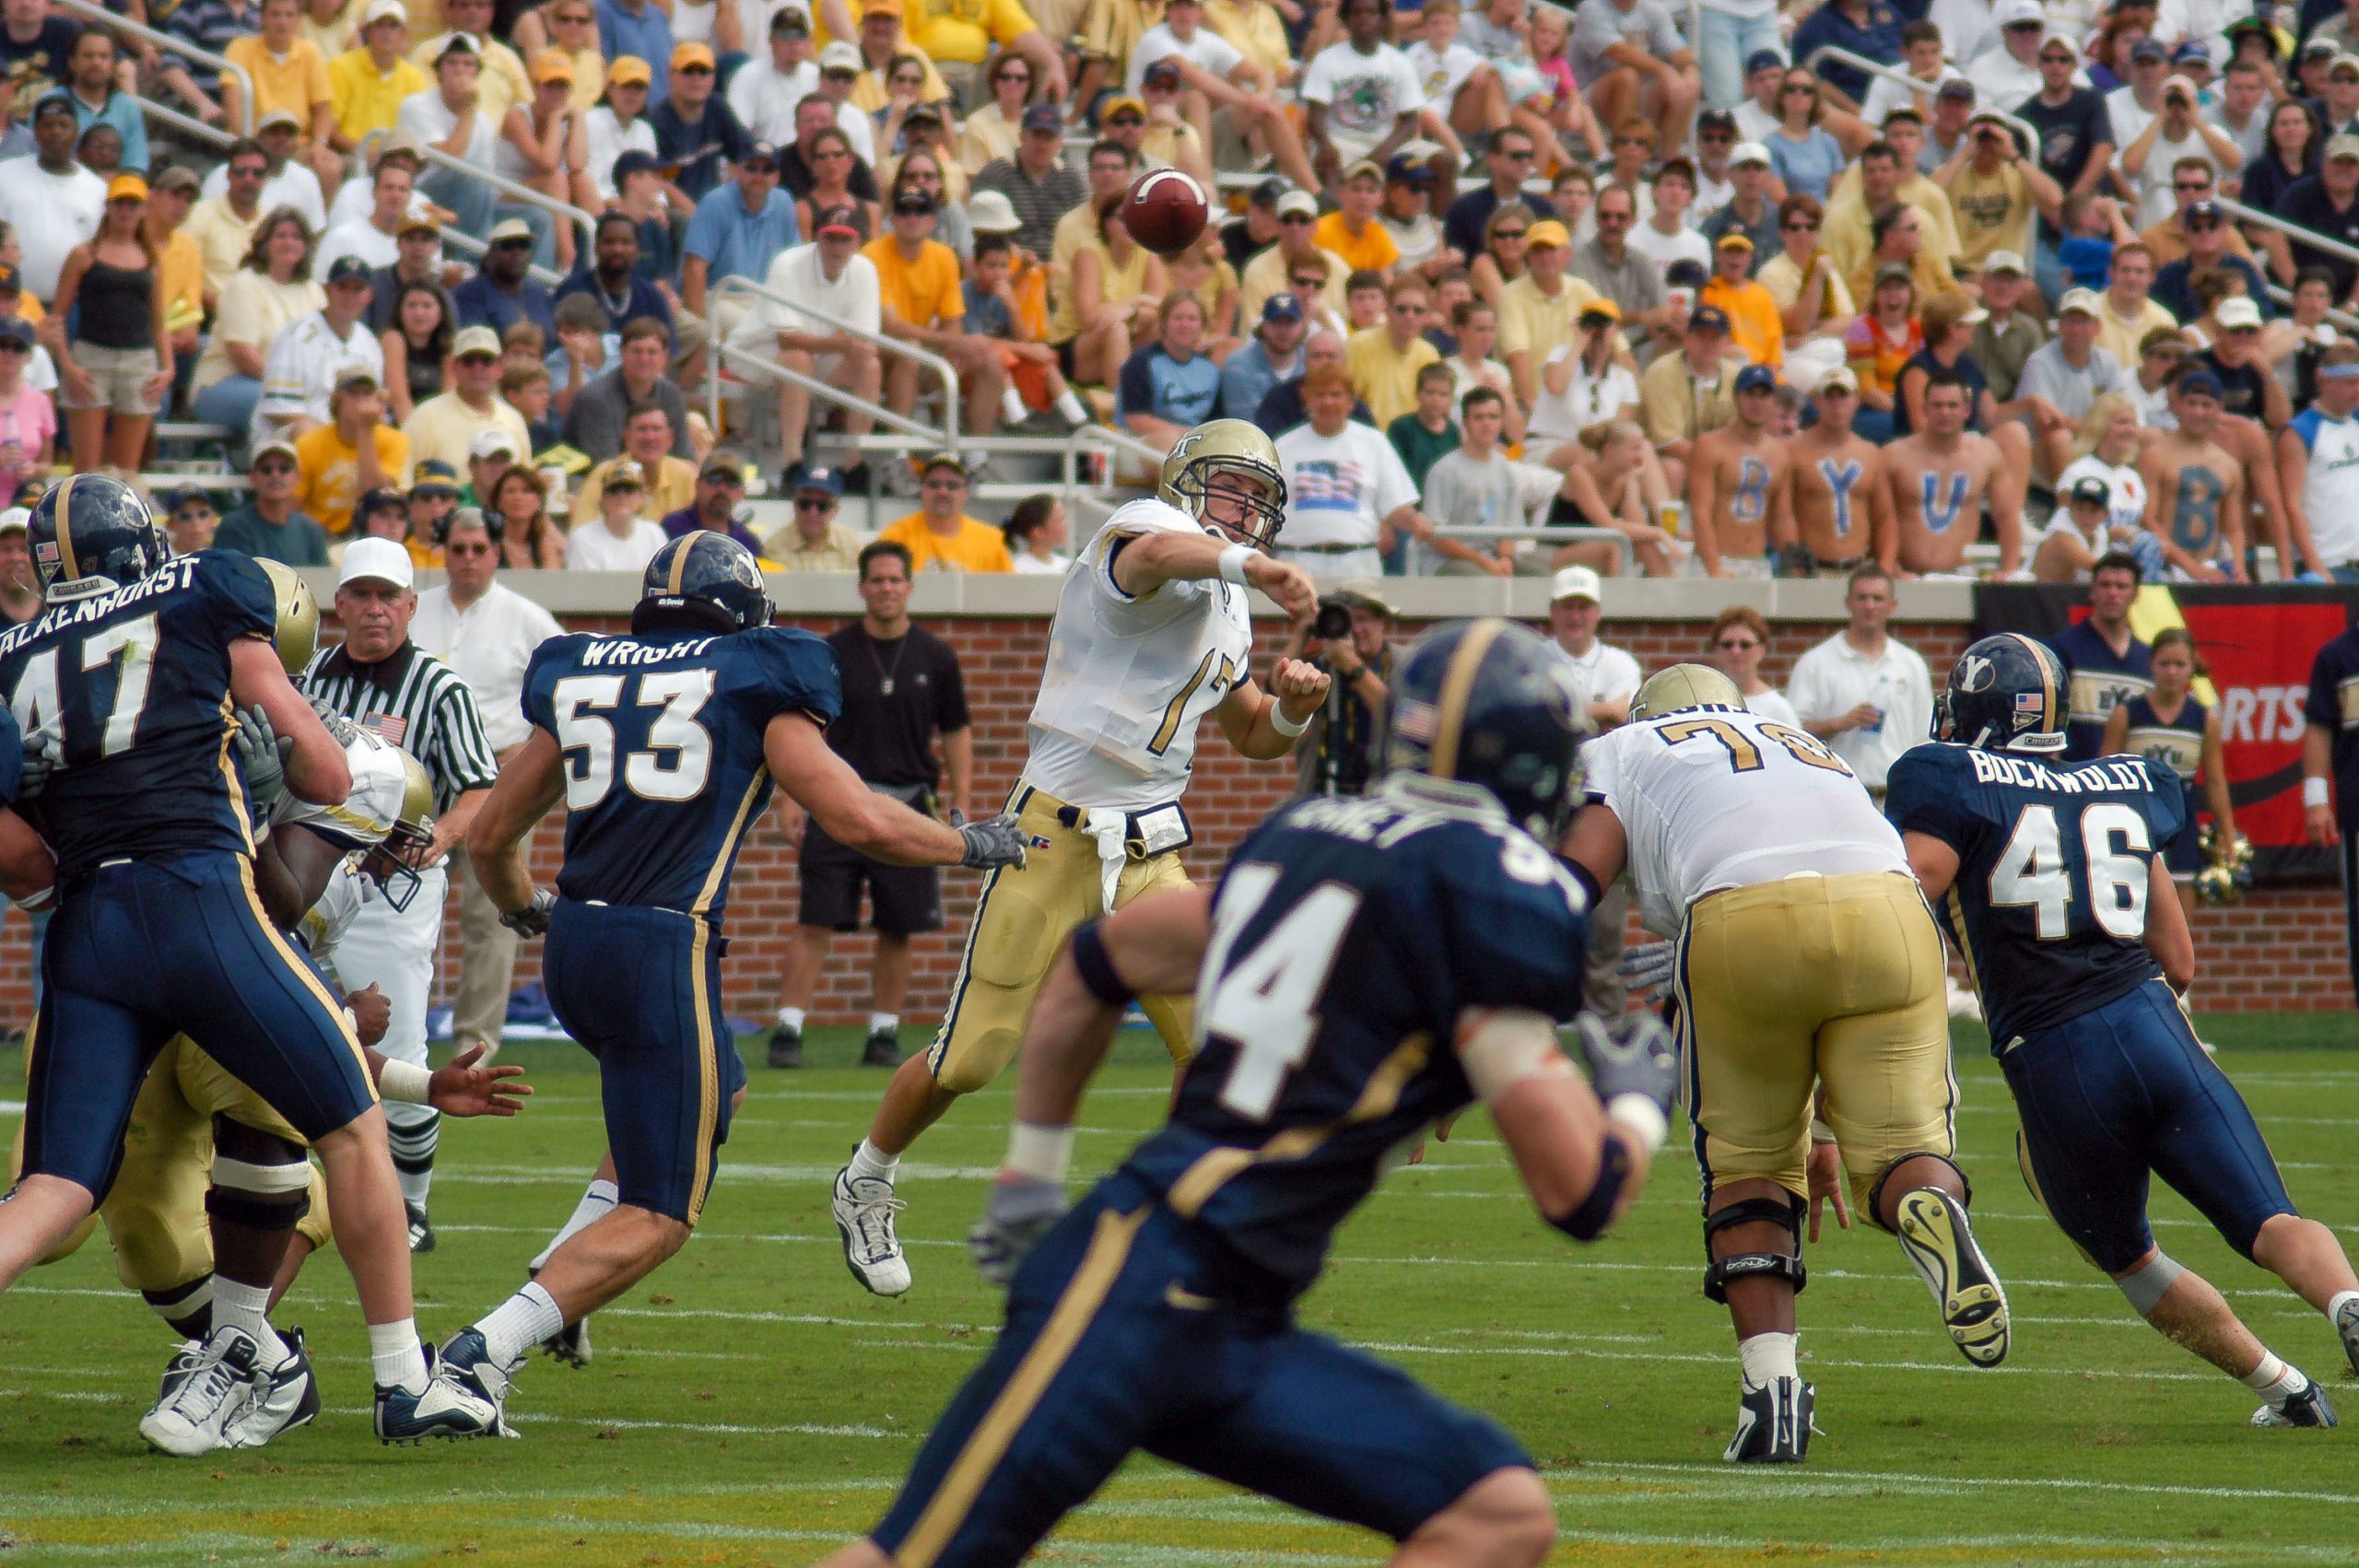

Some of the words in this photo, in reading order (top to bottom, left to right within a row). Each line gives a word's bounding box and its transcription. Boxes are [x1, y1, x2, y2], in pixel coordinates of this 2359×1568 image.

[1731, 457, 1770, 522] B
[1816, 457, 1862, 538] Y
[1920, 472, 1968, 534] U
[2171, 465, 2223, 551] B
[0, 556, 201, 661] ALKENHORST
[10, 610, 161, 770] 47
[1961, 654, 1992, 693] Y
[2219, 684, 2311, 743] RTS
[553, 667, 718, 813] 53
[1966, 748, 2154, 794] BOCKWOLDT
[1988, 802, 2153, 942] 46
